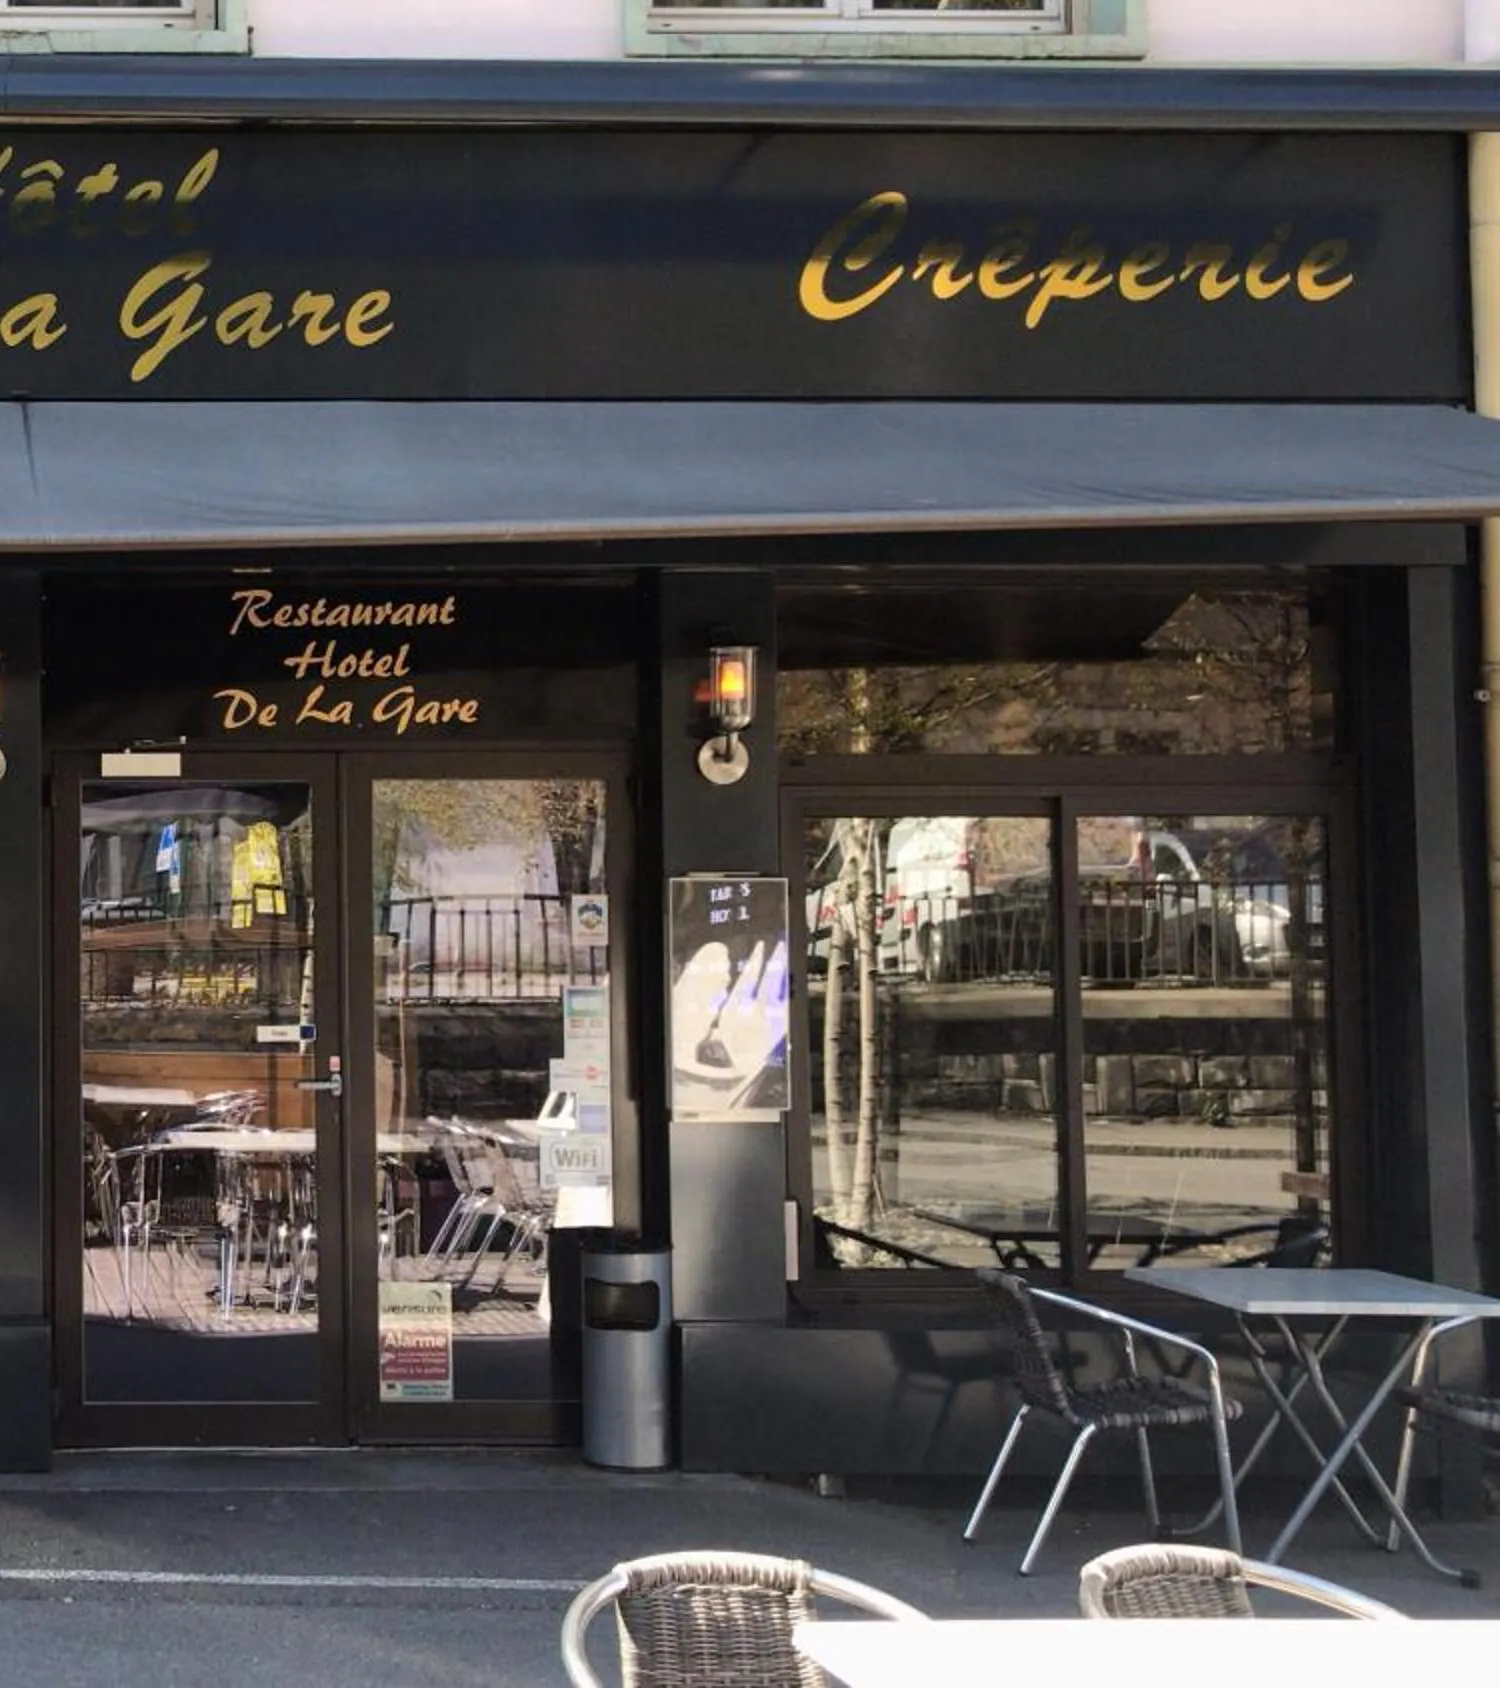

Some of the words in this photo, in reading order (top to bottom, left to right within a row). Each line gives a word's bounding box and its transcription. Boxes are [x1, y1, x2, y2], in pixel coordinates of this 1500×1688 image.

[799, 191, 1356, 330] Crêperie
[118, 251, 395, 383] Gare
[229, 588, 457, 636] Restaurant
[283, 639, 411, 680] Hotel
[212, 688, 278, 730] De
[295, 684, 353, 725] La
[370, 684, 480, 735] Gare
[554, 1147, 598, 1168] WiFi
[382, 1328, 447, 1349] Alarme
